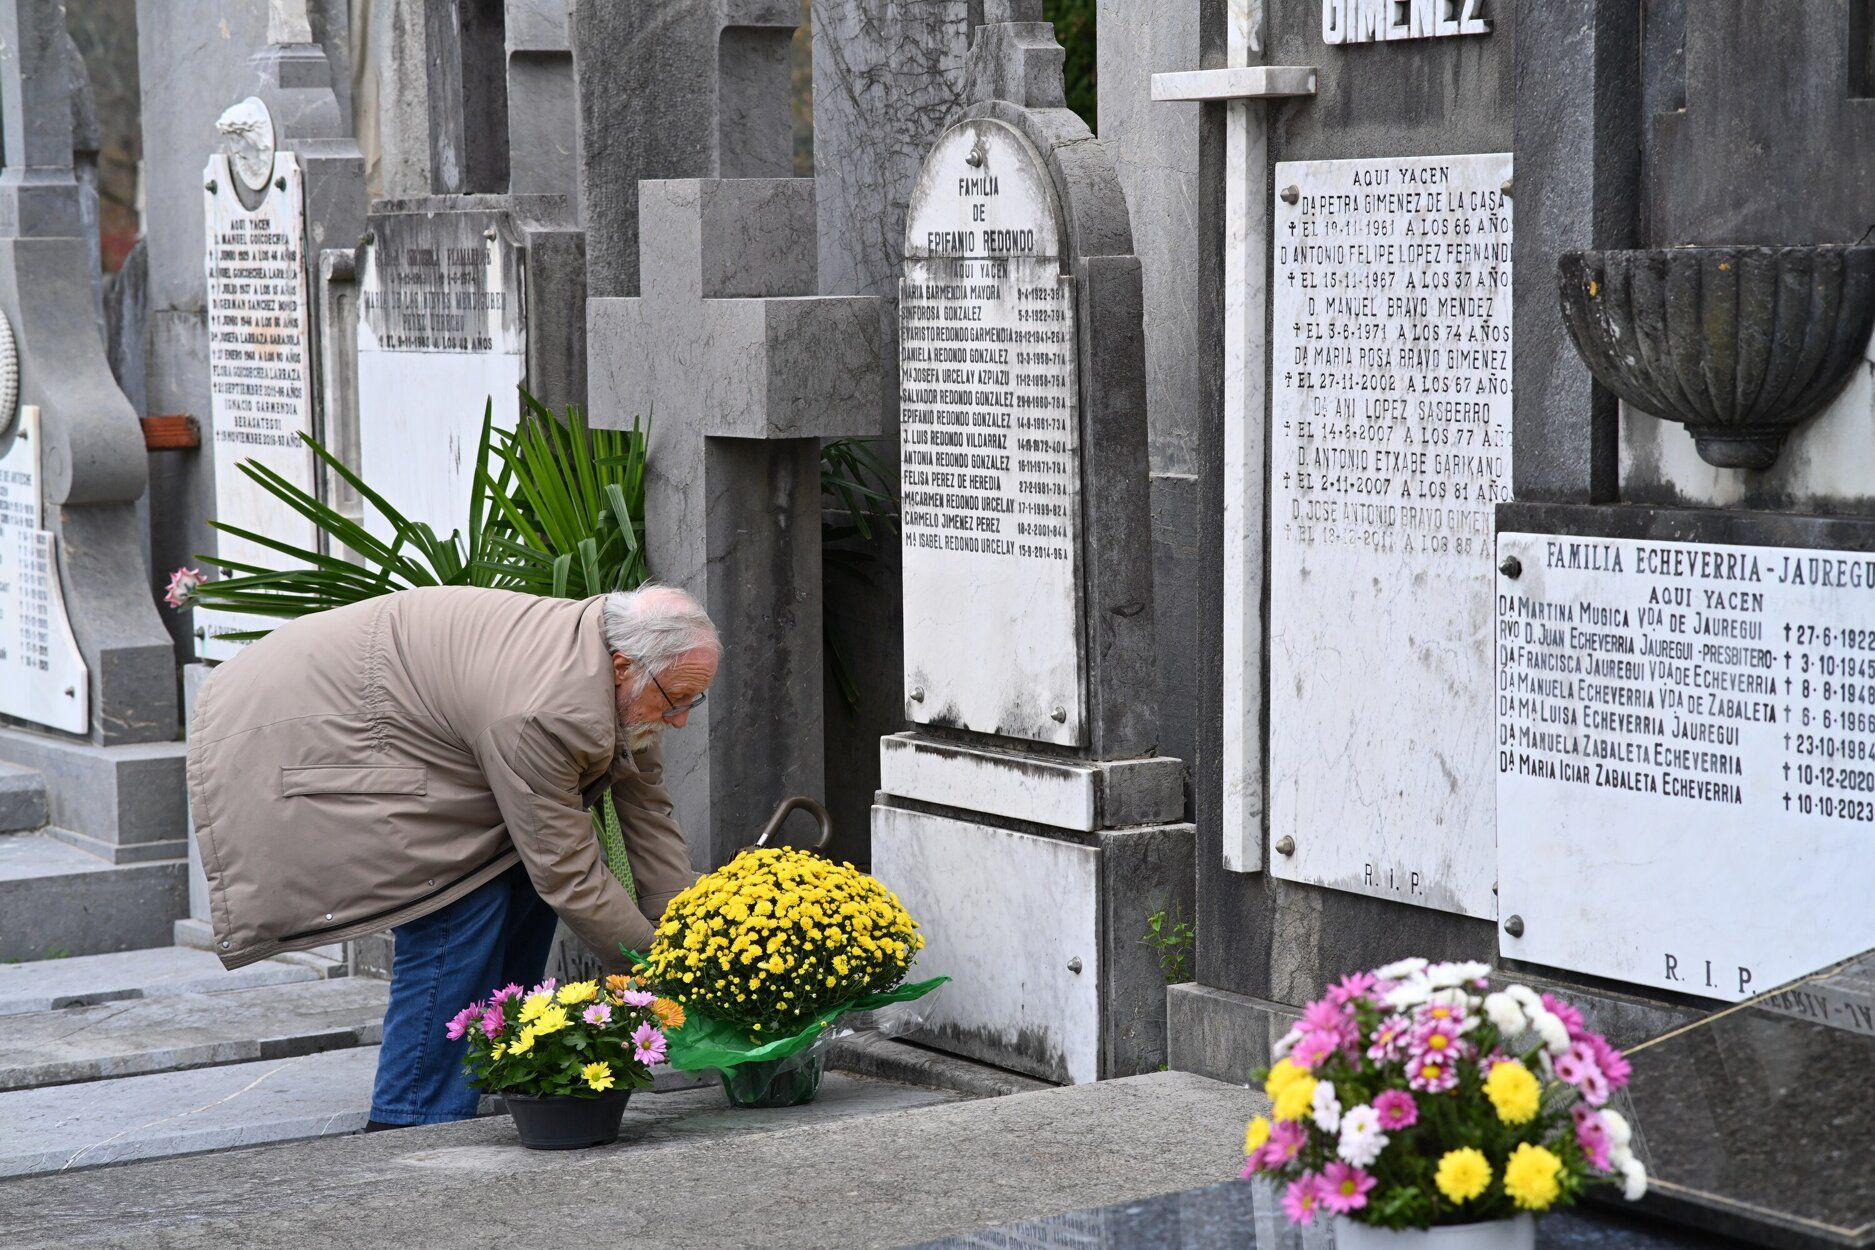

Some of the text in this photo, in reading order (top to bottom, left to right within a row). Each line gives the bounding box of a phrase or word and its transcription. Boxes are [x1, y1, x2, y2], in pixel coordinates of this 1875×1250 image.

[958, 176, 999, 197] FAMILIA
[1353, 166, 1449, 187] AQUI YACEN
[972, 203, 986, 222] DE
[1320, 194, 1359, 215] PETRA
[1364, 193, 1421, 214] GIMENEZ
[1426, 192, 1443, 213] DE
[1448, 191, 1465, 212] LA
[1470, 190, 1505, 212] CASA
[927, 229, 1034, 253] EPIFANIO REDONDO
[1293, 245, 1344, 265] ANTONIO
[1349, 244, 1395, 264] FELIPE
[1399, 243, 1441, 264] LOPEZ
[953, 263, 1008, 279] AQUI YACEN
[1326, 296, 1377, 317] MANUEL
[1387, 297, 1428, 318] BRAVO
[1438, 297, 1493, 318] MENDEZ
[1306, 323, 1323, 339] EL
[1398, 323, 1407, 341] A
[1413, 324, 1440, 341] LOS
[1446, 324, 1462, 342] 74
[1468, 319, 1510, 342] AÑOS
[901, 346, 1009, 364] DANIELA REDONDO GONZALEZ
[1314, 346, 1352, 366] MARIA
[1359, 347, 1392, 368] ROSA
[1399, 348, 1440, 369] BRAVO
[1447, 349, 1507, 370] GIMENEZ
[1297, 372, 1315, 389] EL
[1407, 375, 1416, 392] A
[1421, 375, 1449, 393] LOS
[1455, 376, 1472, 394] 67
[902, 388, 1014, 408] SALVADOR REDONDO GONZALEZ
[1365, 398, 1408, 420] LOPEZ
[1418, 400, 1490, 424] SASBERRO
[912, 429, 928, 445] LUIS
[930, 430, 964, 447] REDONDO
[903, 449, 1010, 472] ANTONIA REDONDO GONZALEZ
[1314, 446, 1368, 470] ANTONIO
[1375, 449, 1427, 474] ETXABE
[1434, 453, 1503, 478] GARIKANO
[903, 469, 930, 486] FELISA
[931, 471, 955, 488] PEREZ
[957, 473, 967, 489] DE
[969, 474, 1001, 492] HEREDIA
[1297, 472, 1314, 490] EL
[1400, 479, 1411, 497] A
[1418, 479, 1446, 498] LOS
[1454, 482, 1468, 500] 81
[904, 510, 939, 528] CARMELO
[941, 513, 974, 531] JIMENEZ
[976, 516, 1001, 534] PEREZ
[1062, 525, 1068, 538] A
[918, 532, 943, 550] ISABEL
[944, 534, 979, 553] REDONDO
[980, 537, 1015, 555] URCELAY
[1063, 548, 1068, 560] A
[1546, 541, 1624, 573] FAMILIA
[1648, 585, 1764, 613] AQUI YACEN
[1518, 596, 1574, 623] MARTINA
[1579, 600, 1630, 629] MUGICA
[1669, 613, 1686, 634] DE
[1693, 611, 1762, 641] JAUREGUI
[1570, 626, 1635, 655] ECHEVERRIA
[1639, 633, 1693, 661] JAUREGUI
[1518, 645, 1582, 674] FRANCISCA
[1585, 653, 1645, 681] JAUREGUI
[1674, 666, 1690, 687] DE
[1693, 664, 1777, 696] ECHEVERRIA
[1518, 671, 1574, 700] MANUELA
[1578, 678, 1654, 709] ECHEVERRIA
[1687, 694, 1704, 715] DE
[1708, 692, 1777, 723] ZABALETA
[1540, 699, 1577, 726] LUISA
[1583, 704, 1665, 737] ECHEVERRIA
[1671, 715, 1740, 747] JAUREGUI
[1519, 725, 1580, 756] MANUELA
[1582, 734, 1651, 765] ZABALETA
[1654, 742, 1743, 777] ECHEVERRIA
[1519, 752, 1556, 780] MARIA
[1560, 759, 1590, 784] ICIAR
[1595, 763, 1657, 793] ZABALETA
[1662, 771, 1743, 805] ECHEVERRIA
